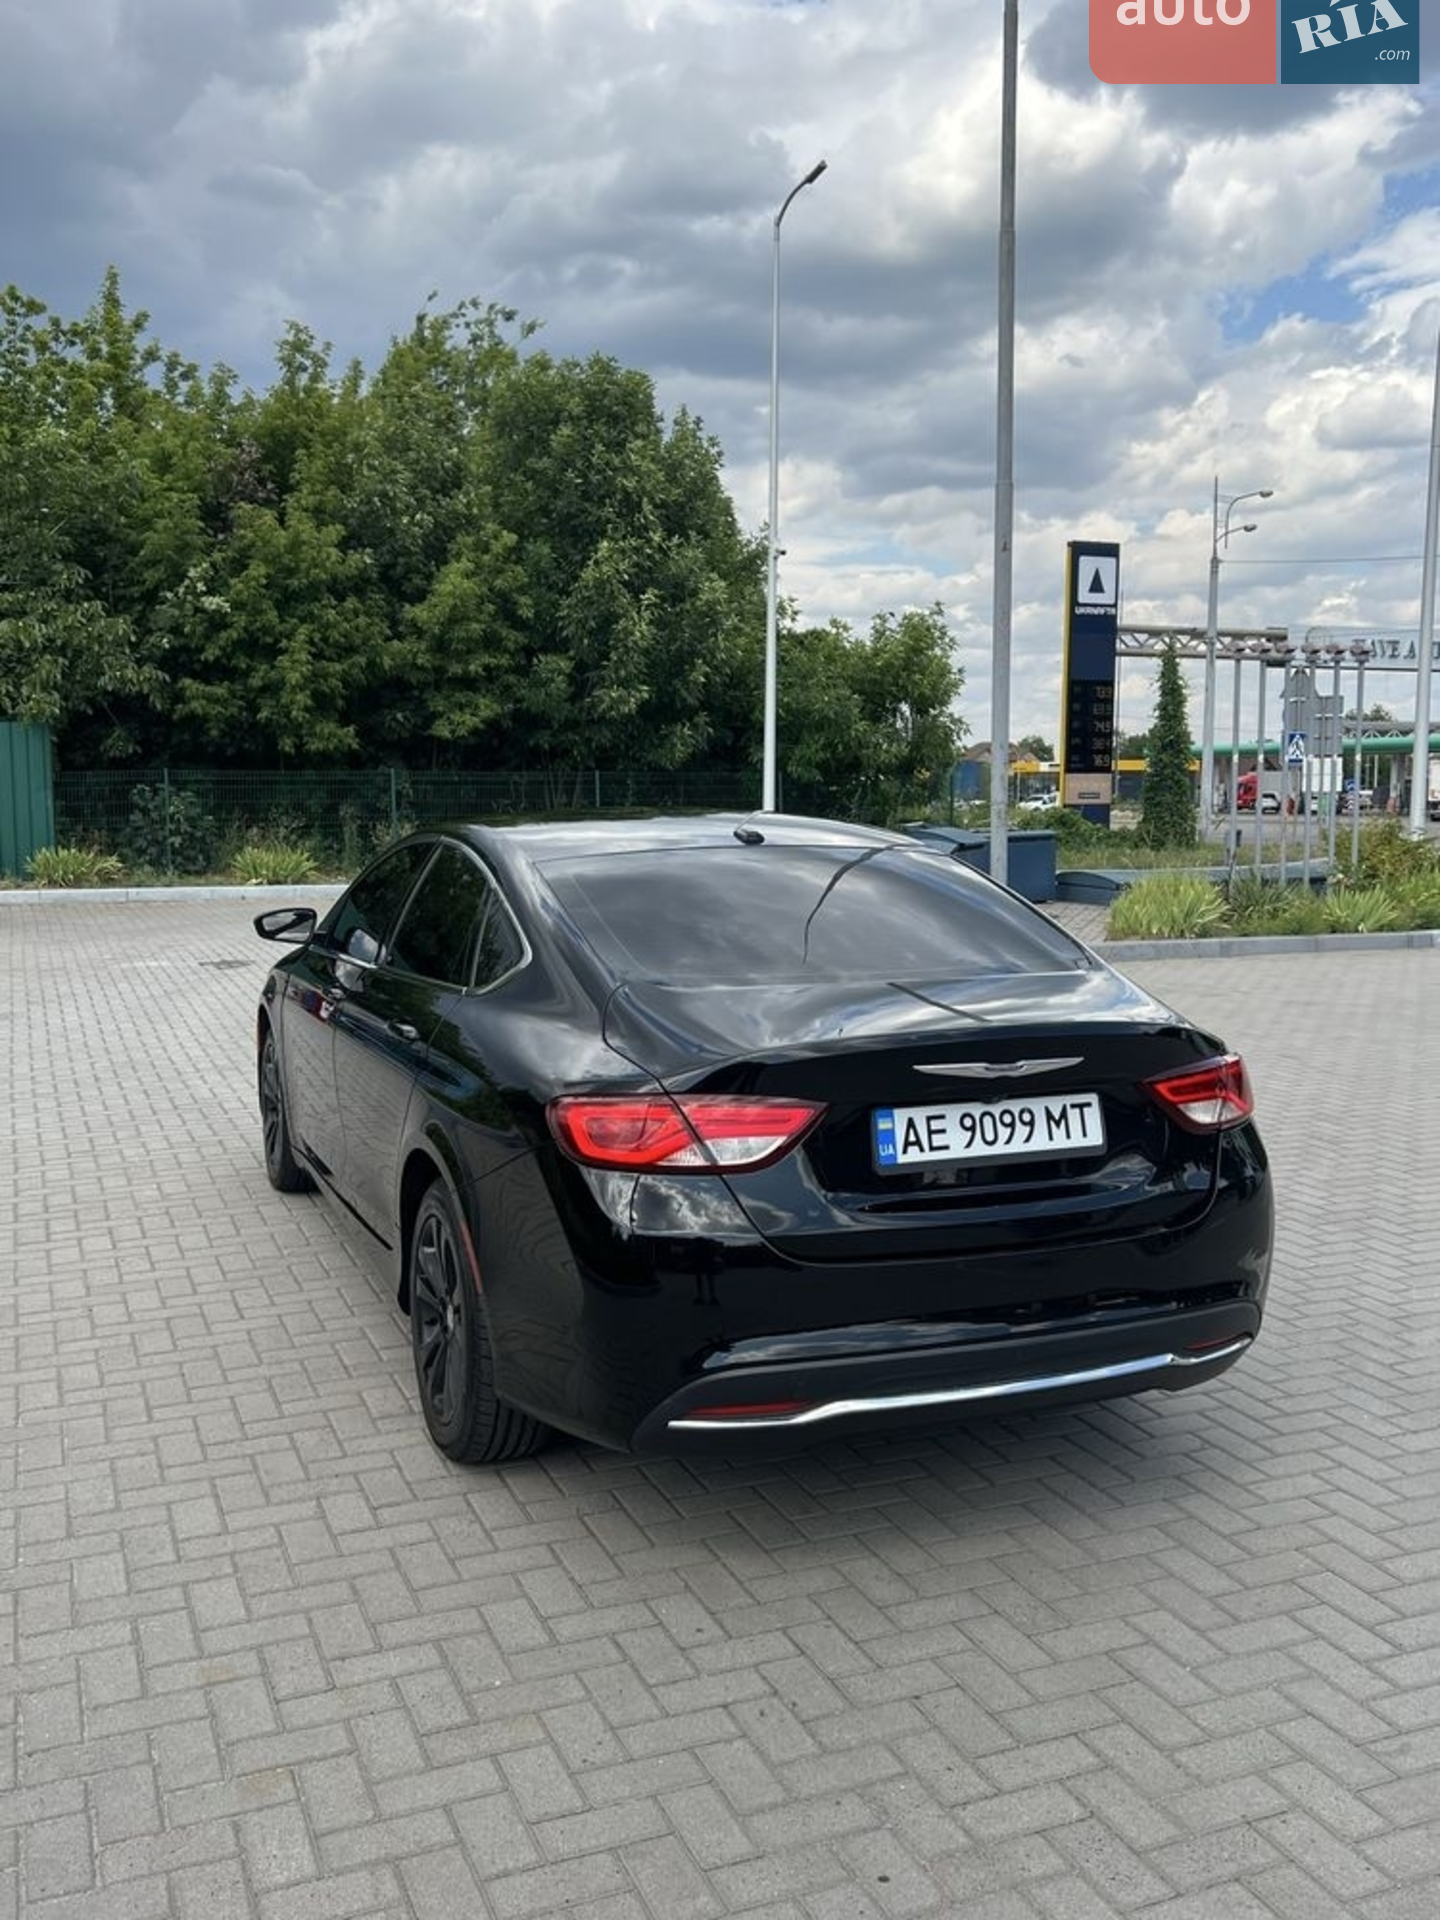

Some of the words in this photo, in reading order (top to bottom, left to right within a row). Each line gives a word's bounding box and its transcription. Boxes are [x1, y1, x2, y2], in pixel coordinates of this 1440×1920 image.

[902, 1114, 950, 1155] AE
[959, 1107, 1036, 1149] 9099
[1044, 1101, 1093, 1142] MT
[879, 1144, 895, 1157] UA
